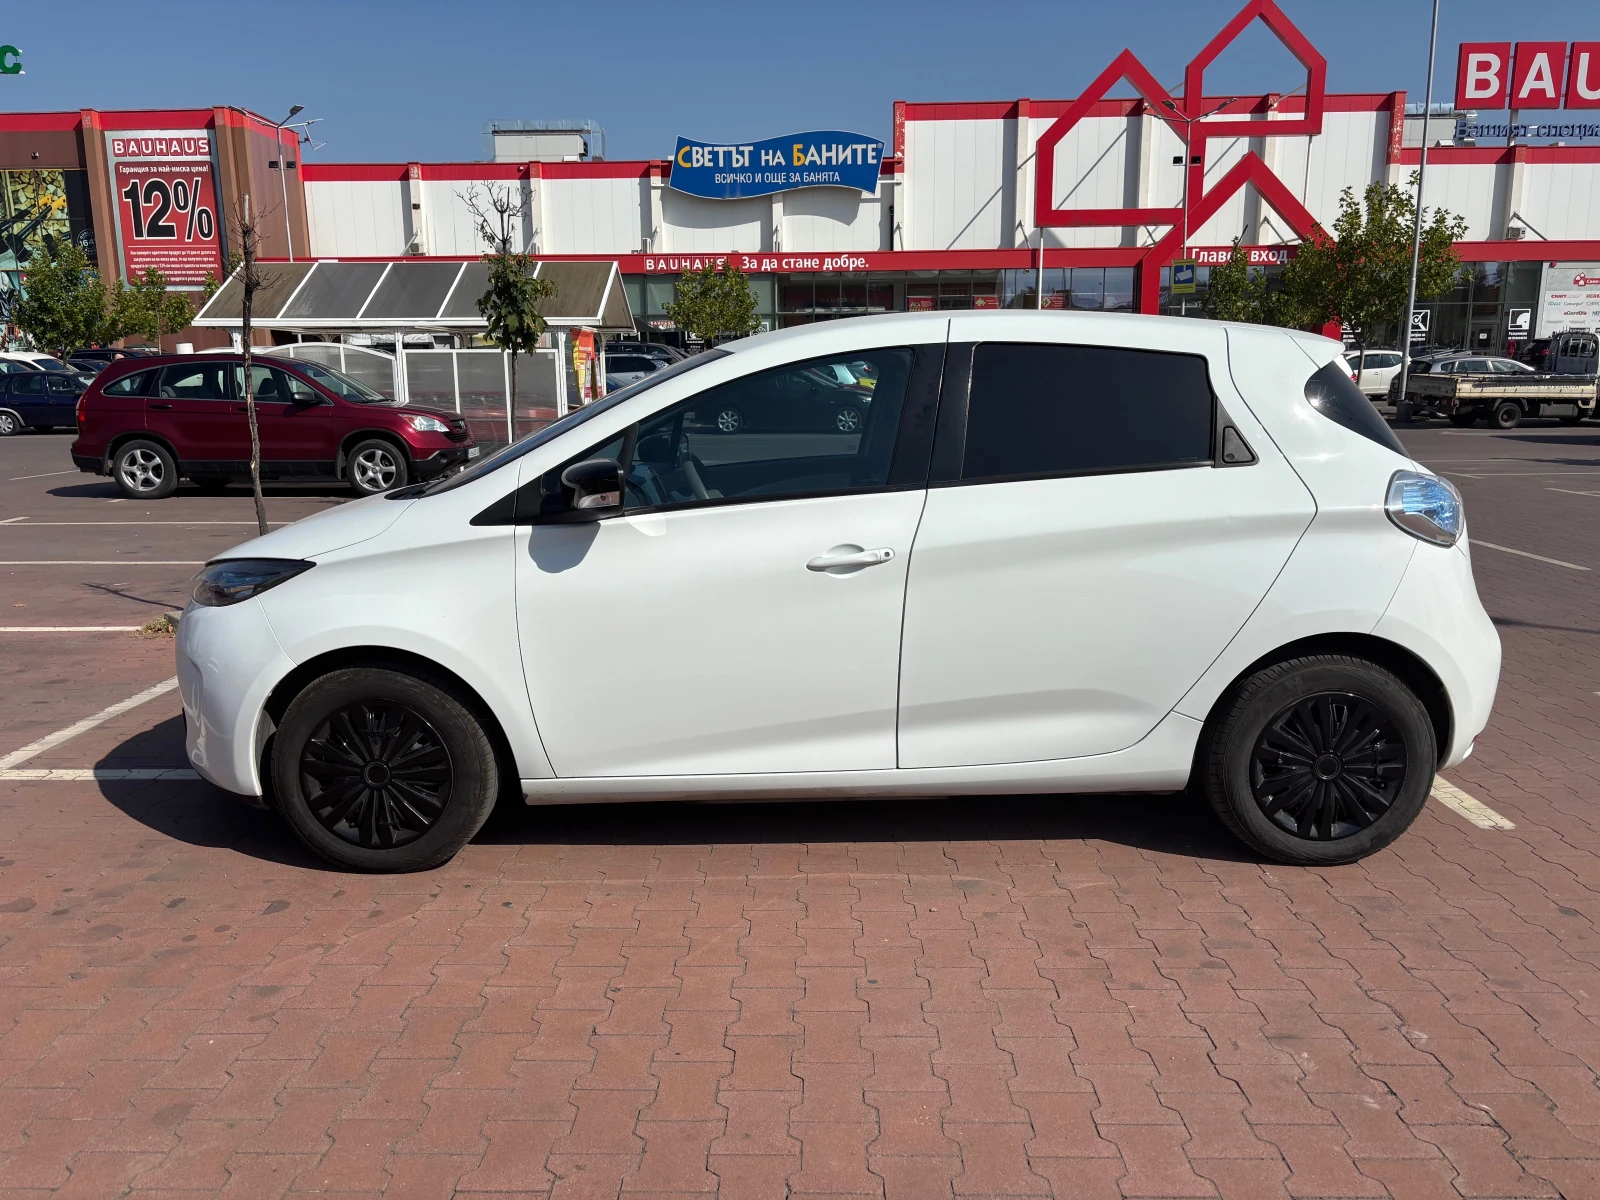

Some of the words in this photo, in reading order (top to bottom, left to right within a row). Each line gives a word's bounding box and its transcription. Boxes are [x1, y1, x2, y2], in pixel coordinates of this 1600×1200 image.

[1465, 53, 1600, 99] BAU
[114, 139, 208, 154] BAUHAUS
[119, 165, 149, 174] Гаранция
[191, 165, 209, 173] цена!
[715, 172, 752, 184] ВСИЧКО
[755, 173, 762, 183] И
[765, 173, 786, 184] ОЩЕ
[789, 172, 801, 183] ЗА
[803, 171, 841, 182] БАНЯТА
[122, 177, 215, 242] 12%
[742, 256, 758, 268] За
[761, 259, 778, 271] да
[782, 257, 819, 269] стане
[823, 254, 869, 271] добре.
[1251, 249, 1288, 264] вход
